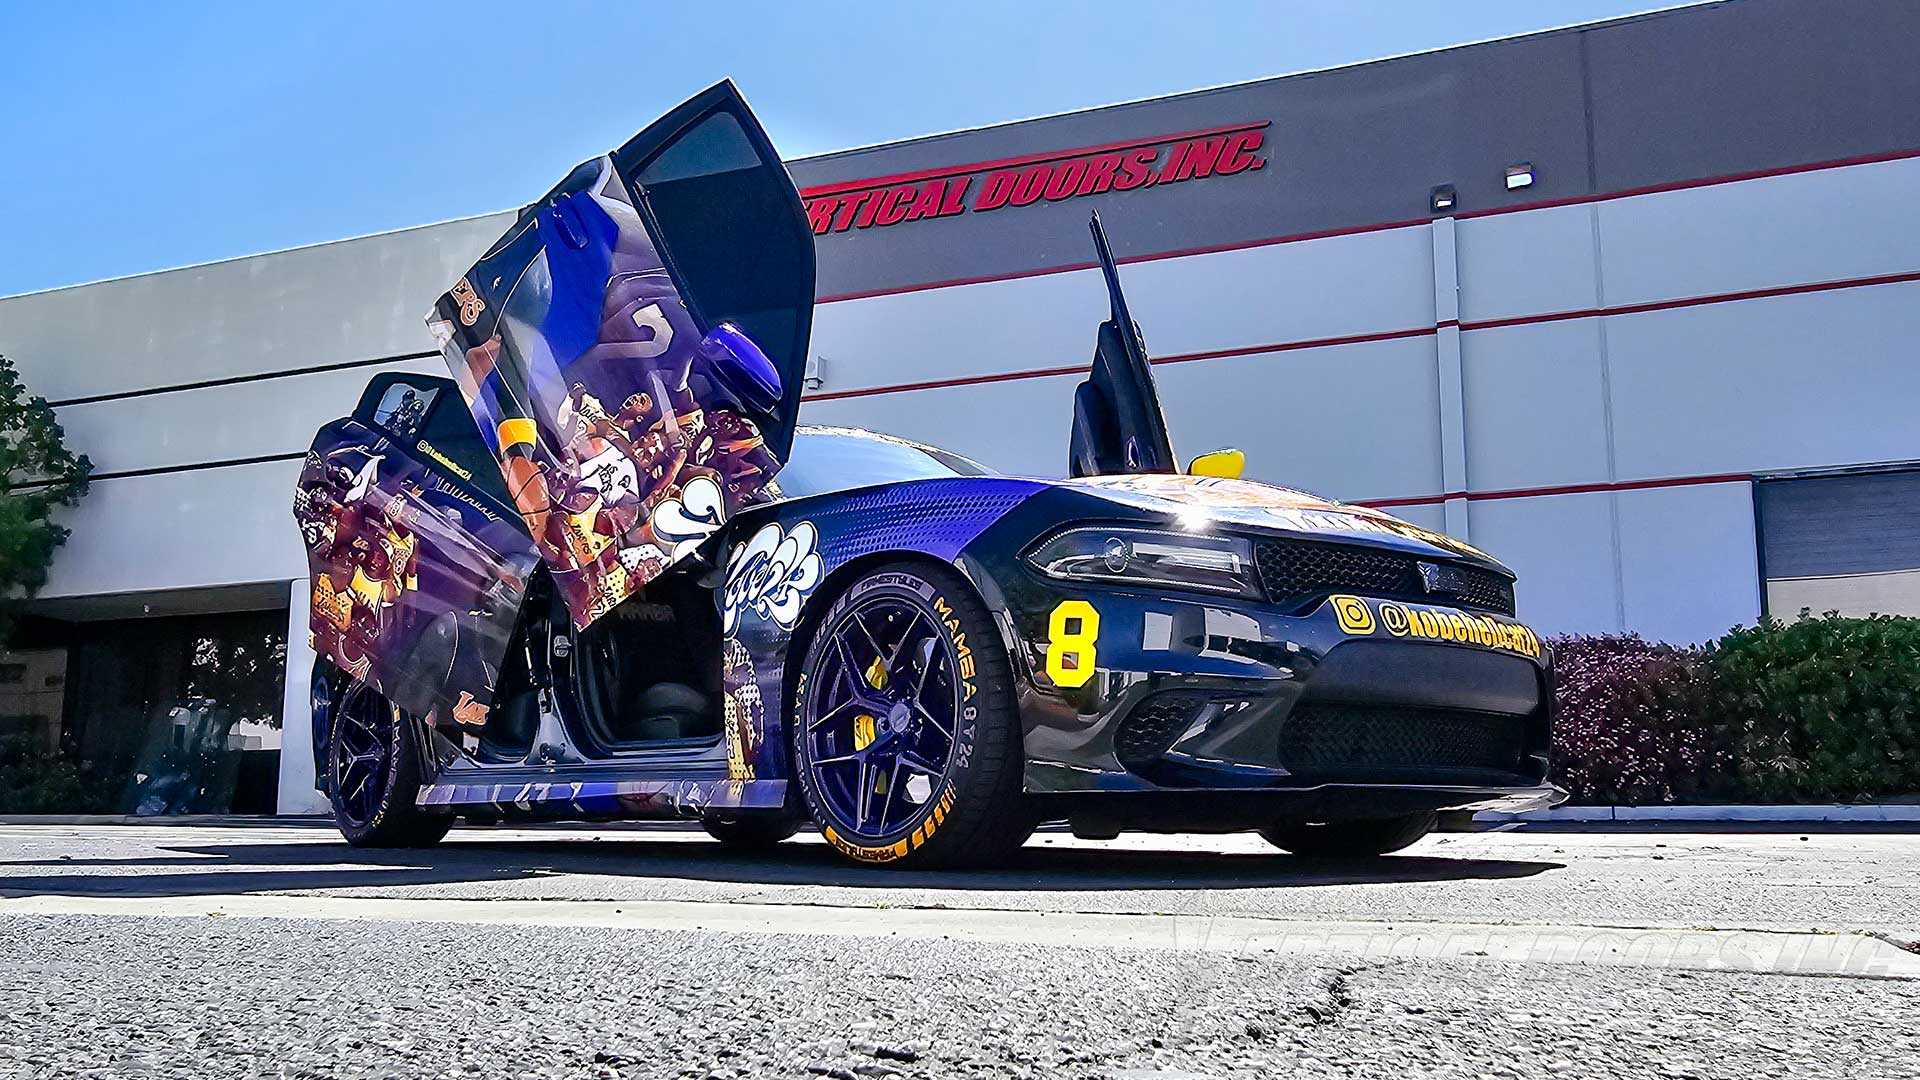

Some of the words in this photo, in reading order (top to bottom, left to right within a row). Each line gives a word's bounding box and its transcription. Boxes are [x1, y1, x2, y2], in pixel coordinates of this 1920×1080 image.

[804, 176, 976, 236] RTICAL
[934, 596, 978, 703] MAMBA
[1046, 600, 1101, 688] 8
[1377, 602, 1541, 658] @kobehellcat24
